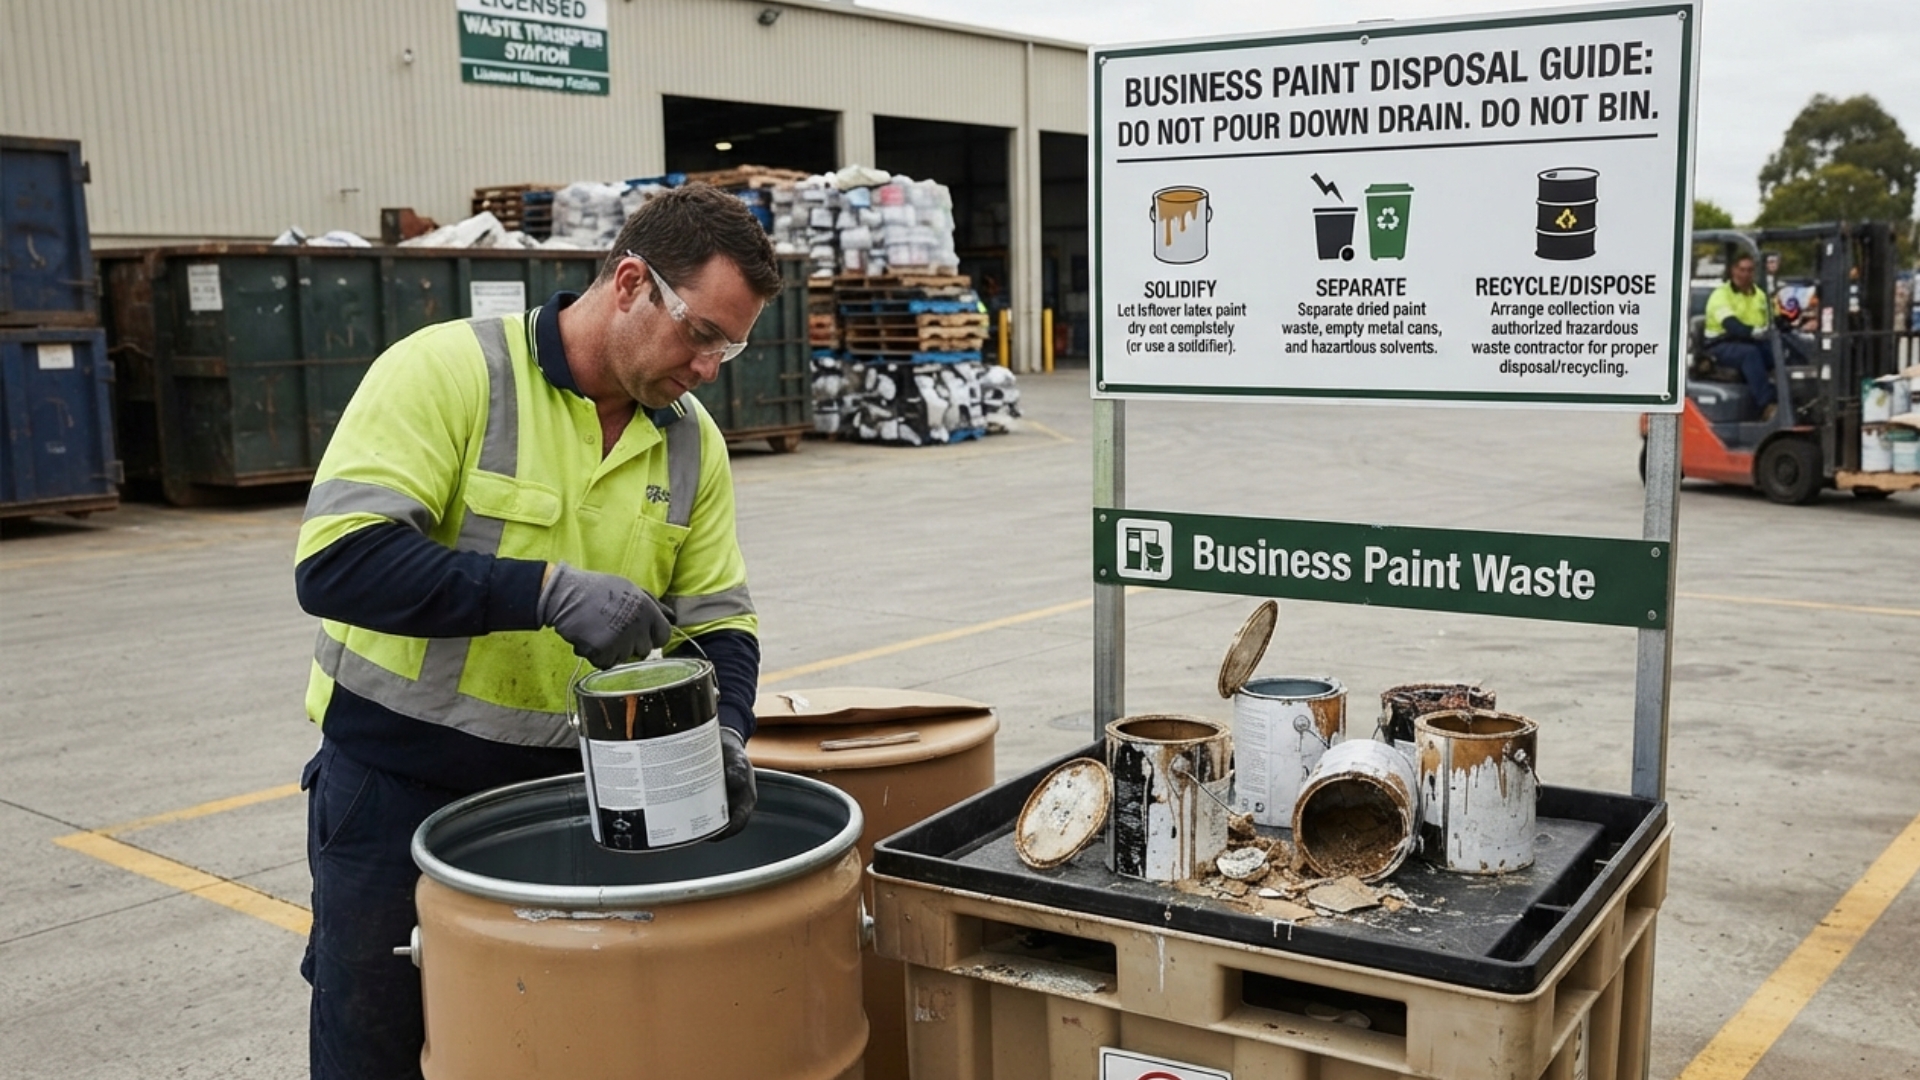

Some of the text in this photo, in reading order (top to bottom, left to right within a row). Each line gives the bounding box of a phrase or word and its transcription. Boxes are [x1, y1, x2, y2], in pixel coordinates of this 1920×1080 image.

[463, 14, 524, 40] WASTE
[1124, 40, 1653, 108] BUSINESS PAINT DISPOSAL GUIDE:
[1118, 89, 1659, 147] DO NOT POUR DOWN DRAIN. DO NOT BIN.
[1143, 279, 1218, 299] SOLIDIFY
[1315, 277, 1407, 298] SEPARATE
[1475, 274, 1657, 297] RECYCLE/DISPOSE
[1215, 302, 1248, 320] paint
[1356, 300, 1390, 316] dried
[1392, 301, 1427, 320] paint
[1490, 300, 1640, 319] Arrange collection via
[1127, 320, 1146, 338] dry
[1281, 319, 1443, 339] waste, empty metal cans,
[1491, 319, 1563, 336] authorized
[1144, 341, 1166, 353] use
[1167, 341, 1175, 353] a
[1284, 339, 1308, 354] and
[1379, 339, 1438, 354] solvents.
[1471, 339, 1660, 359] waste contractor for proper
[1498, 358, 1629, 378] disposal/recycling.
[1193, 535, 1597, 600] Business Paint Waste
